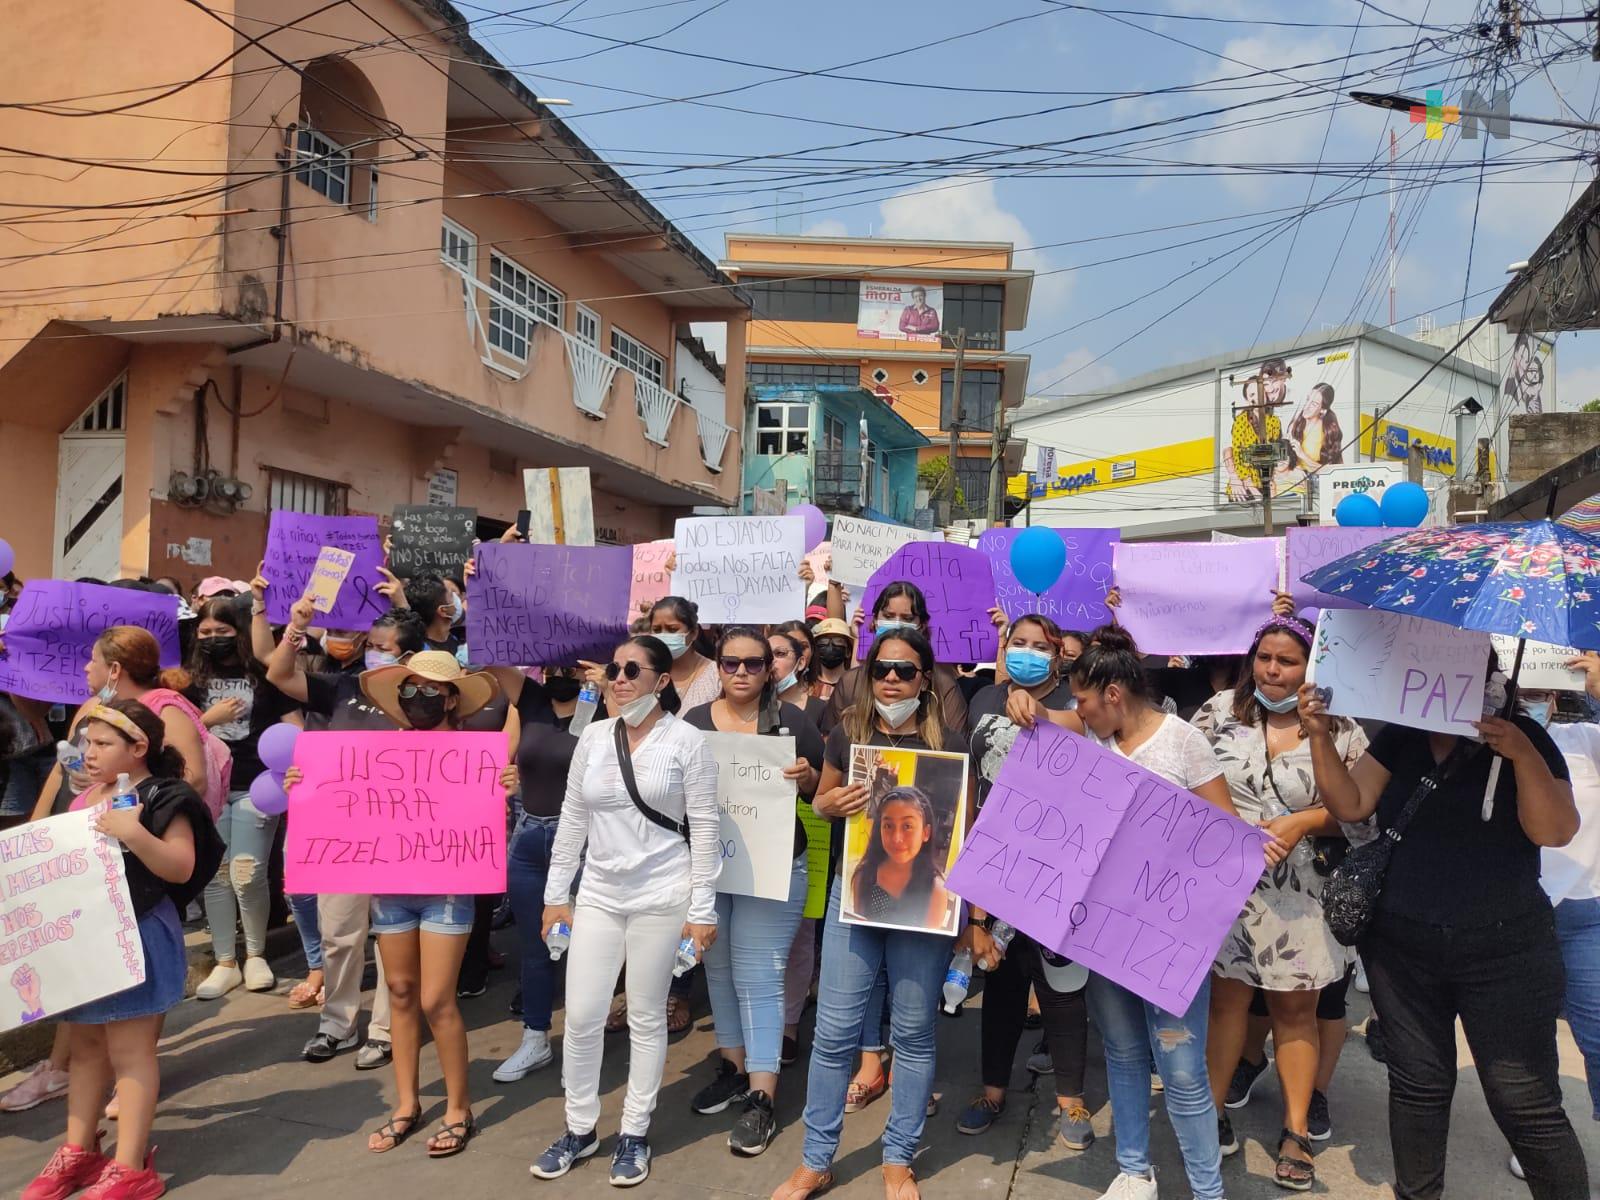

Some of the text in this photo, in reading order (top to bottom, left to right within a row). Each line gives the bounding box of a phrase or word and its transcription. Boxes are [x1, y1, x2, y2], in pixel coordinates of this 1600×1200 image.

[866, 290, 901, 301] mora
[685, 518, 784, 548] NO ESTAMOS
[836, 519, 856, 534] NO
[981, 535, 1008, 553] NO
[748, 550, 798, 572] FALTA
[687, 574, 794, 601] ITZEL DAYANA
[1400, 668, 1475, 723] PAZ
[316, 746, 501, 796] JUSTICIA
[729, 754, 772, 782] tanto
[333, 787, 440, 822] PARA
[1019, 722, 1262, 888] NO ESTAMOS
[296, 825, 500, 870] ITZEL DAYANA
[997, 782, 1198, 923] TODAS NOS
[7, 847, 89, 898] MENOS
[958, 829, 1064, 918] FALTA
